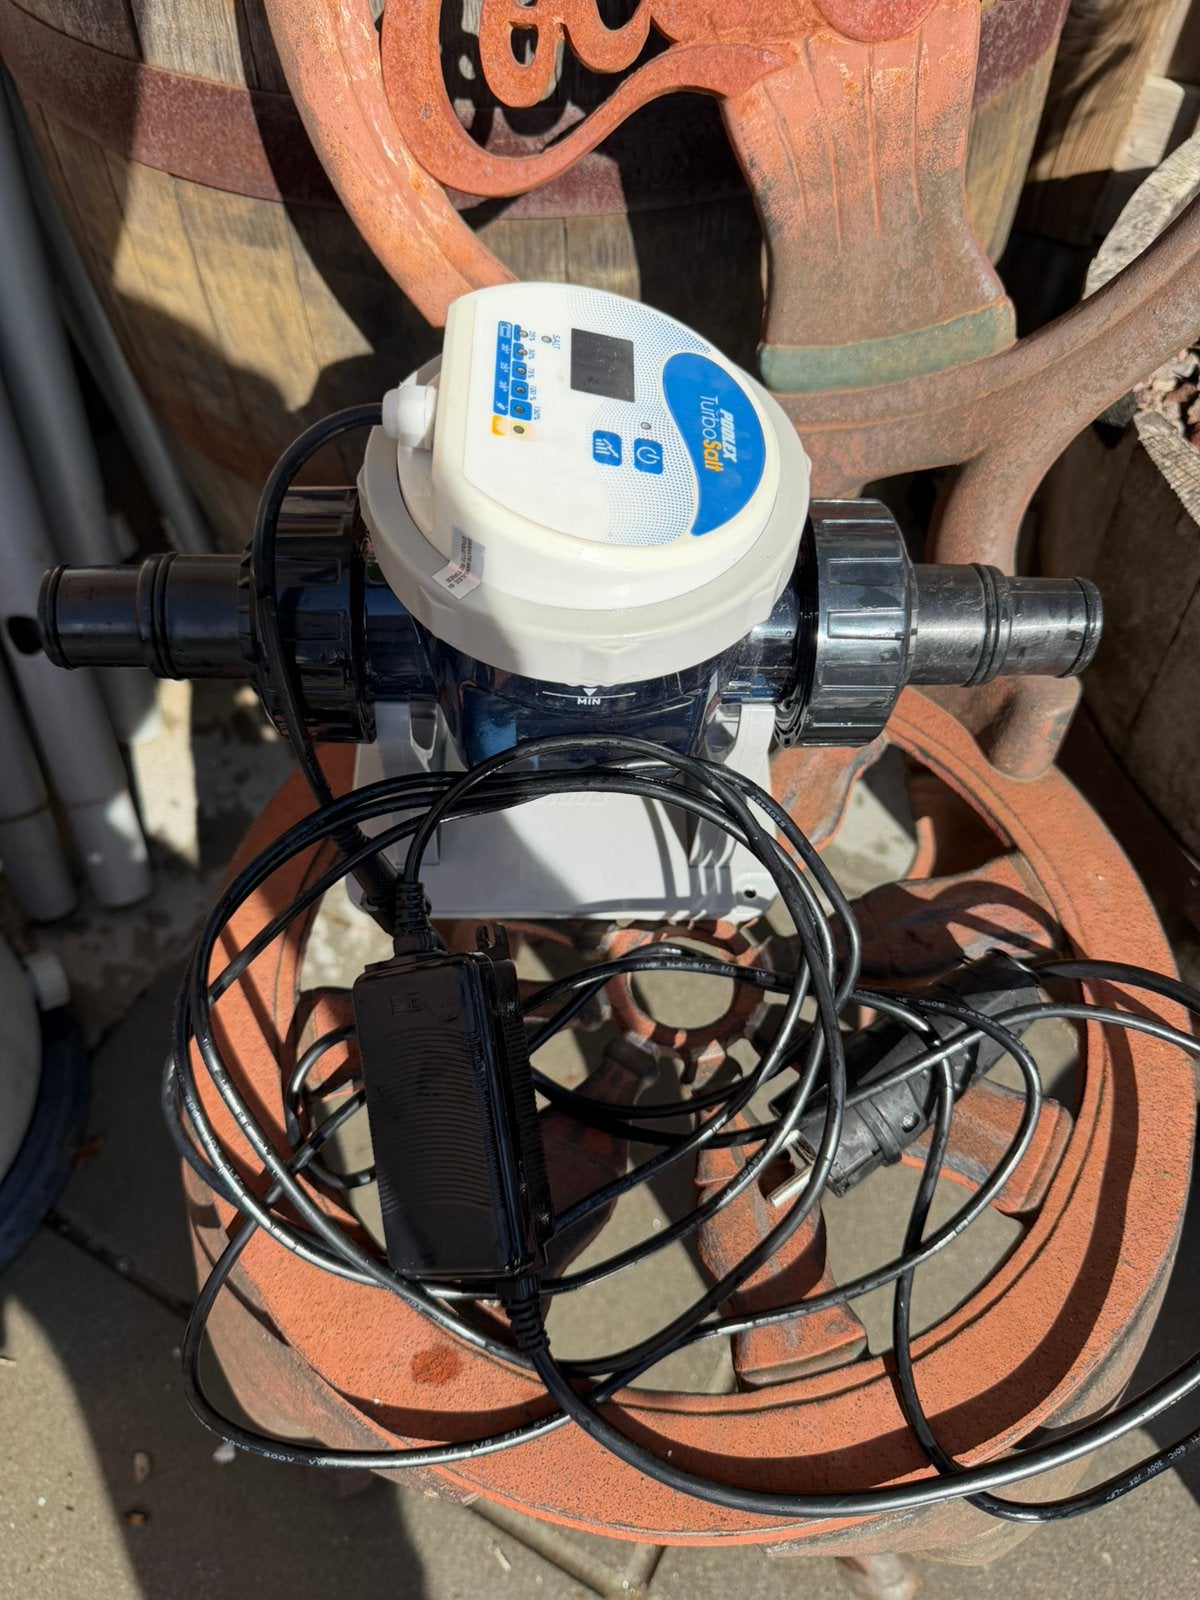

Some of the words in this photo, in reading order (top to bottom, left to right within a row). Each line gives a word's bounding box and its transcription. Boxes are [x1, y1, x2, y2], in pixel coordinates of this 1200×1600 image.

[552, 334, 561, 350] SALT
[720, 408, 737, 463] POOLEX
[577, 697, 601, 705] MIN
[1147, 1460, 1163, 1476] 300V
